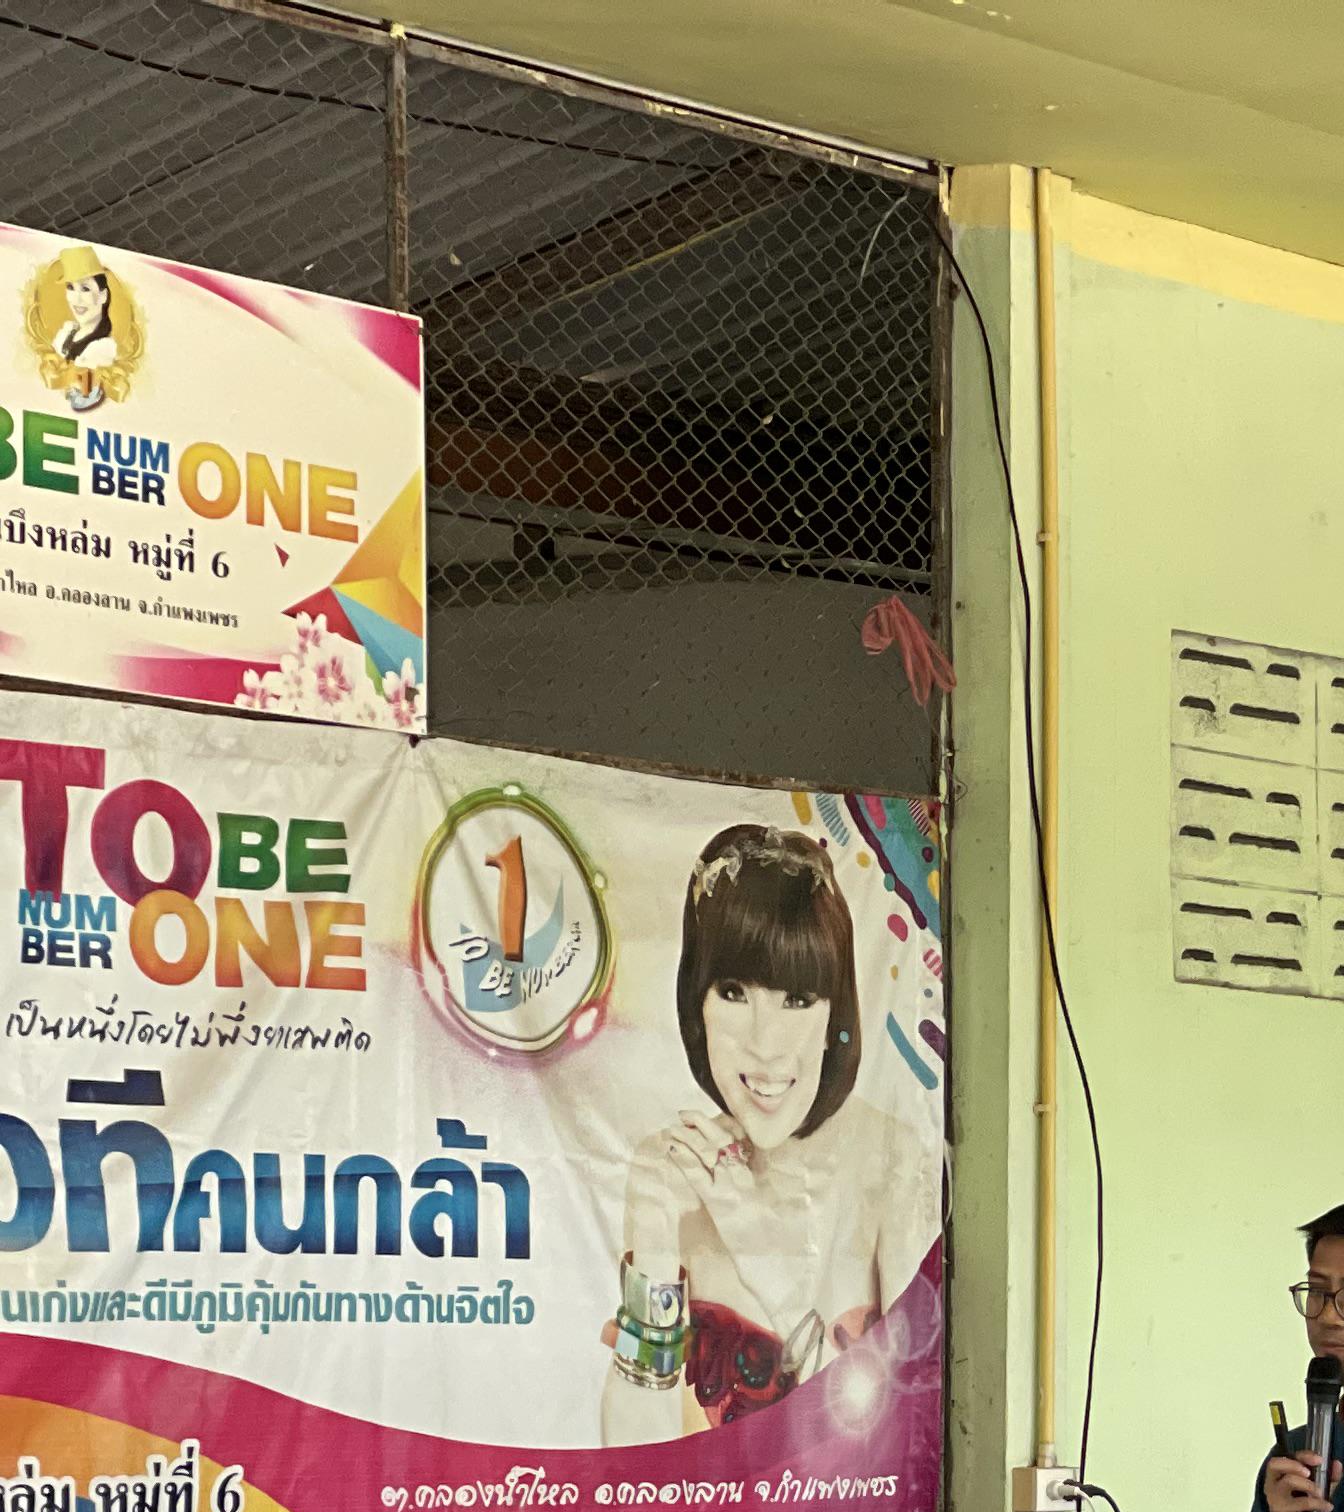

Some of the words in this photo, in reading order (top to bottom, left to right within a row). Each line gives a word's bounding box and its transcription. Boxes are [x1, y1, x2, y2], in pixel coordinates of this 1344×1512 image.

[87, 427, 170, 474] NUM
[178, 441, 358, 543] ONE
[91, 462, 166, 506] BER
[0, 507, 112, 560] บึงหล่ม
[128, 528, 196, 582] หมู่ที่
[211, 550, 231, 579] 6
[45, 583, 131, 613] อ.คลองลาน
[0, 738, 212, 906] TO
[216, 811, 351, 894] BE
[18, 888, 118, 932] NUM
[128, 888, 367, 992] ONE
[20, 928, 114, 970] BER
